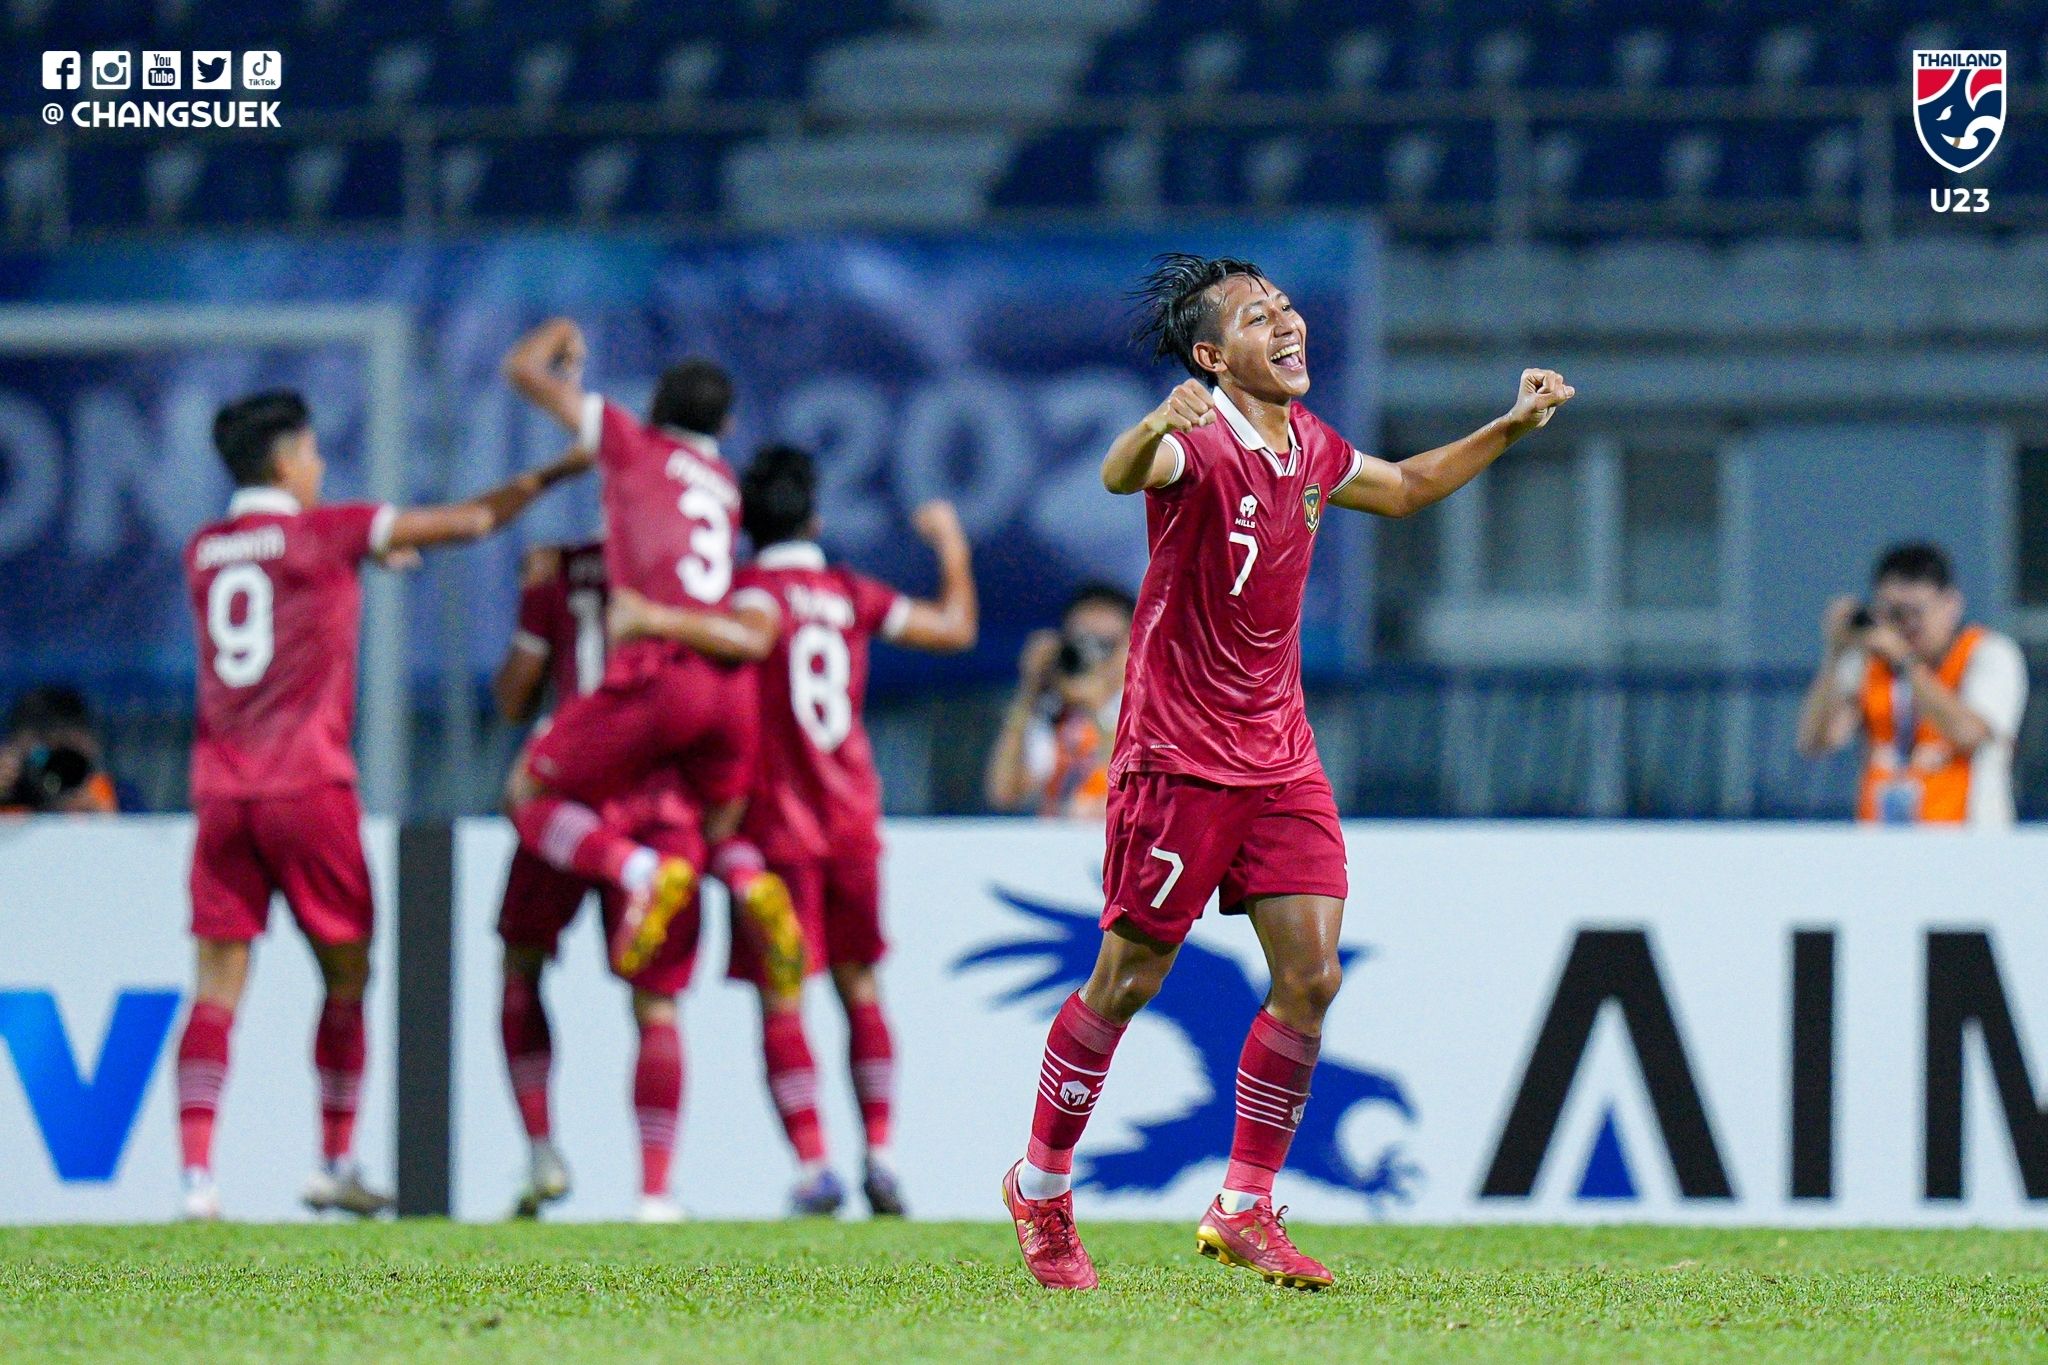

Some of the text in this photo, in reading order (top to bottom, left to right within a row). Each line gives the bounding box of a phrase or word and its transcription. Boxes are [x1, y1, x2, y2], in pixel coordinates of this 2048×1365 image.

[676, 488, 732, 604] 3
[1229, 531, 1259, 597] 7
[1235, 517, 1256, 529] MILLS
[208, 563, 274, 689] 9
[789, 622, 851, 753] 8
[1150, 846, 1184, 909] 7
